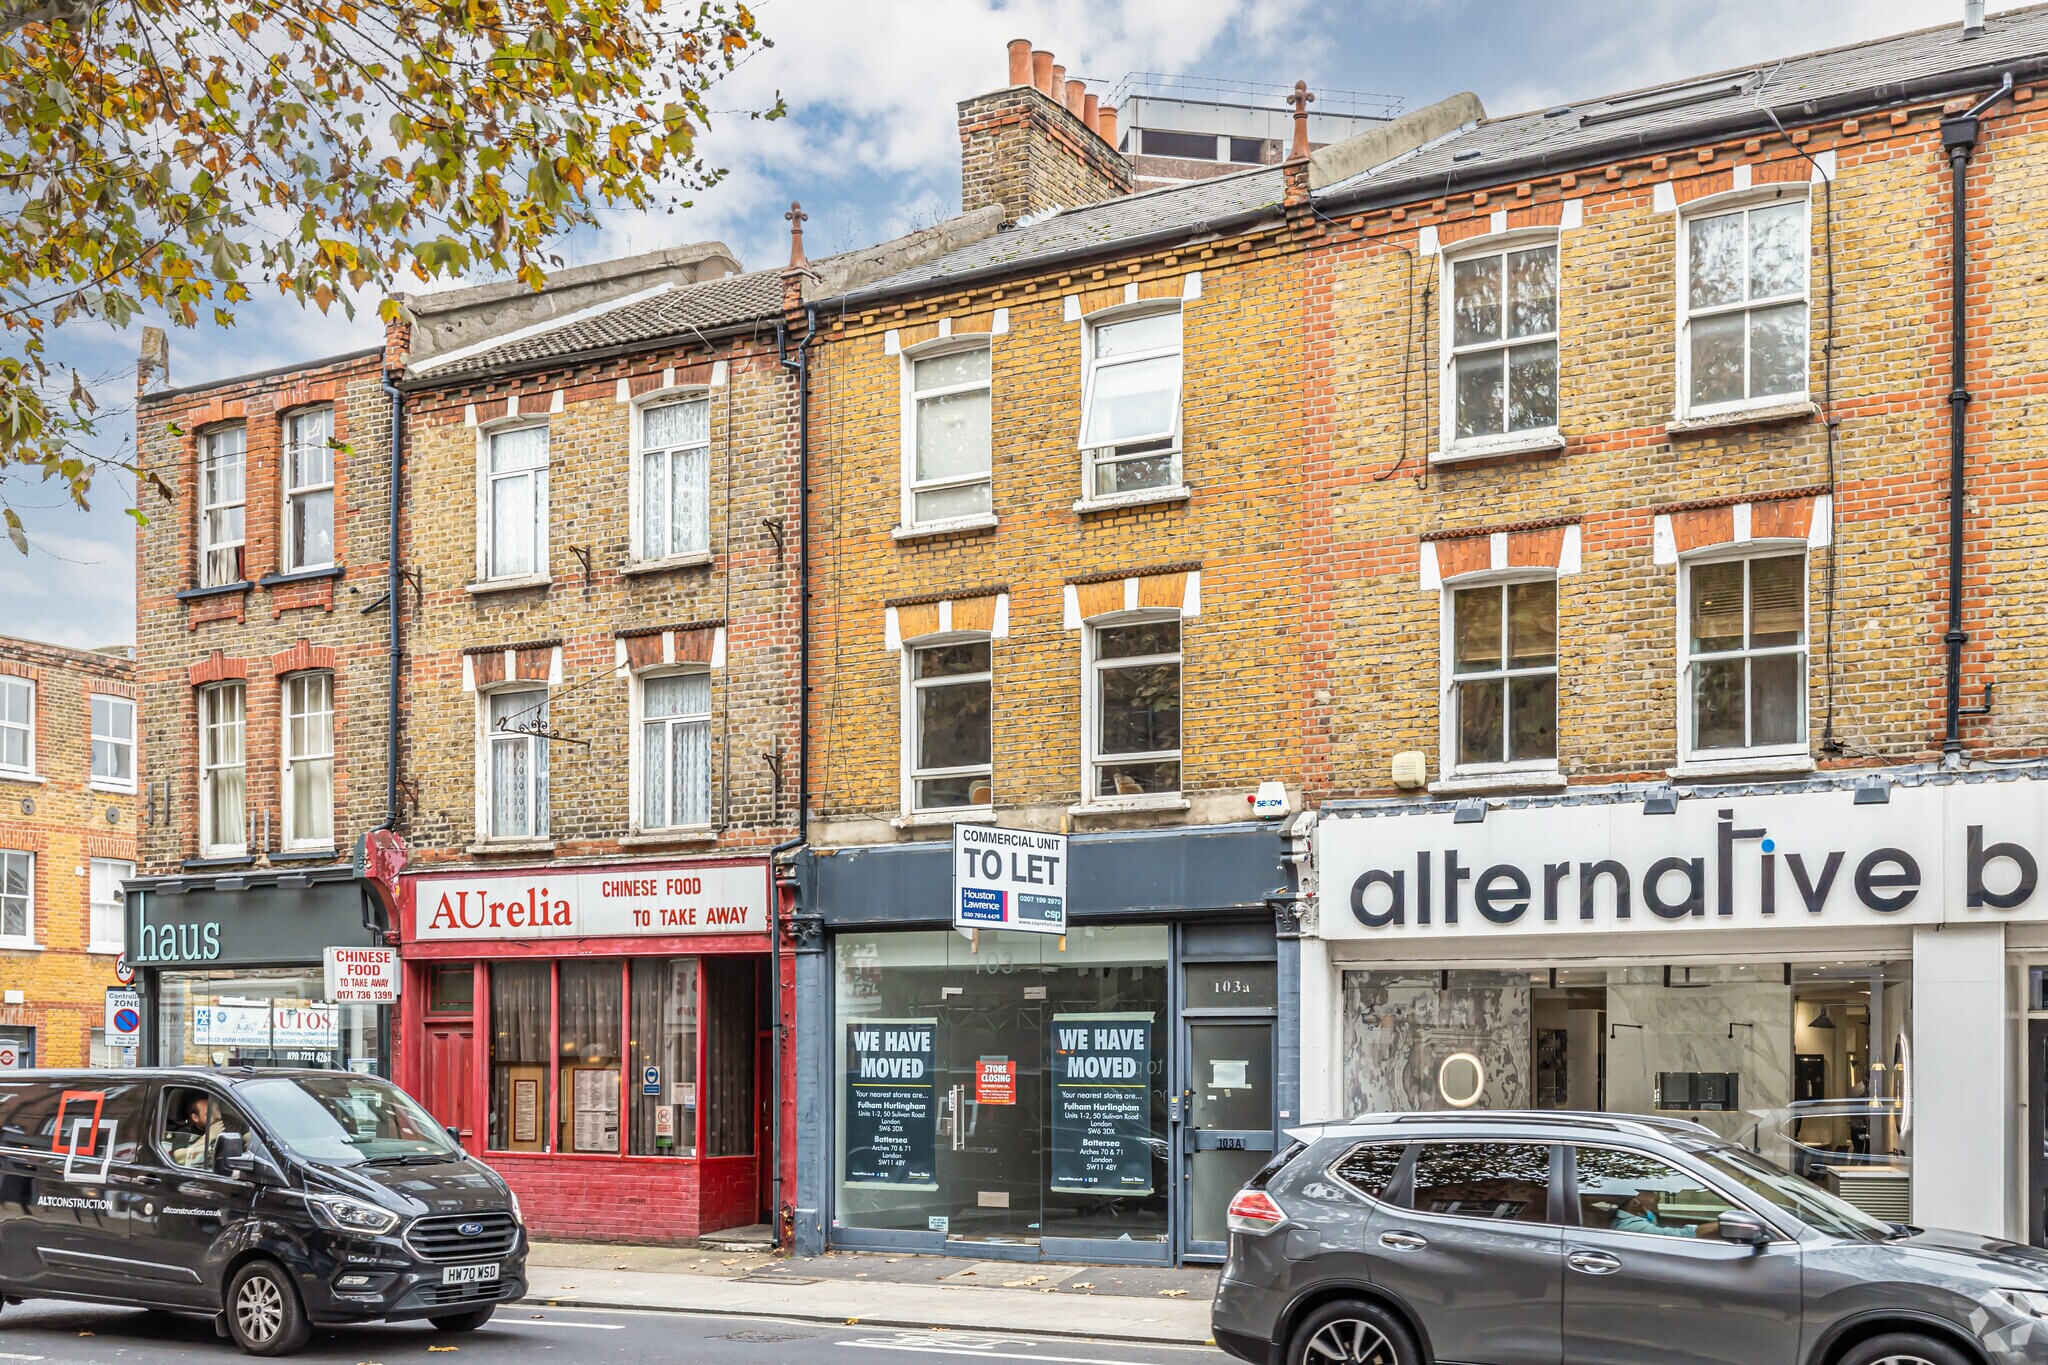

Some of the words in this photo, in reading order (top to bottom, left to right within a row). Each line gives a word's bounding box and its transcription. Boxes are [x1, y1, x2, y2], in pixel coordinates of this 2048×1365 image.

[1257, 799, 1282, 807] SECOM
[963, 829, 1034, 848] COMMERCIAL
[1037, 838, 1060, 850] UNIT
[963, 847, 1002, 880] TO
[1011, 852, 1060, 885] LET
[1351, 809, 1921, 927] alternative
[602, 879, 657, 898] CHINESE
[666, 877, 701, 895] FOOD
[963, 889, 996, 901] Houston
[429, 887, 572, 929] AUrelia
[963, 899, 1000, 910] Lawrence
[633, 909, 651, 926] TO
[660, 907, 697, 926] TAKE
[706, 906, 748, 924] AWAY
[1044, 909, 1061, 922] csp
[137, 891, 220, 961] haus
[1018, 920, 1062, 928] www.cspretail.com
[336, 950, 391, 963] CHINESE
[976, 952, 1013, 974] 103
[347, 964, 380, 976] FOOD
[340, 978, 348, 987] TO
[351, 978, 369, 987] TAKE
[371, 978, 389, 987] AWAY
[1215, 980, 1250, 993] 103a
[336, 990, 353, 1000] 0171
[356, 990, 371, 1000] 736
[374, 990, 393, 1000] 1399
[853, 1031, 879, 1052] WE
[885, 1031, 931, 1052] HAVE
[1059, 1029, 1088, 1050] WE
[1094, 1029, 1144, 1050] HAVE
[861, 1058, 924, 1078] MOVED
[984, 1065, 1007, 1073] STORE
[1067, 1057, 1137, 1078] MOVED
[981, 1074, 1011, 1082] CLOSING
[1077, 1091, 1102, 1099] nearest
[1103, 1091, 1123, 1099] stores
[857, 1101, 882, 1109] Fulham
[884, 1102, 926, 1111] Hurlingham
[1064, 1103, 1091, 1111] Fulham
[1093, 1103, 1139, 1112] Hurlingham
[1080, 1112, 1091, 1120] 1-2,
[1082, 1139, 1120, 1147] Battersea
[1218, 1138, 1241, 1149] 103A
[37, 1195, 113, 1210] ALTCONSTRUCTION
[162, 1206, 222, 1217] altconstruction.co.uk
[448, 1268, 476, 1281] HW70
[477, 1266, 496, 1279] WSD
